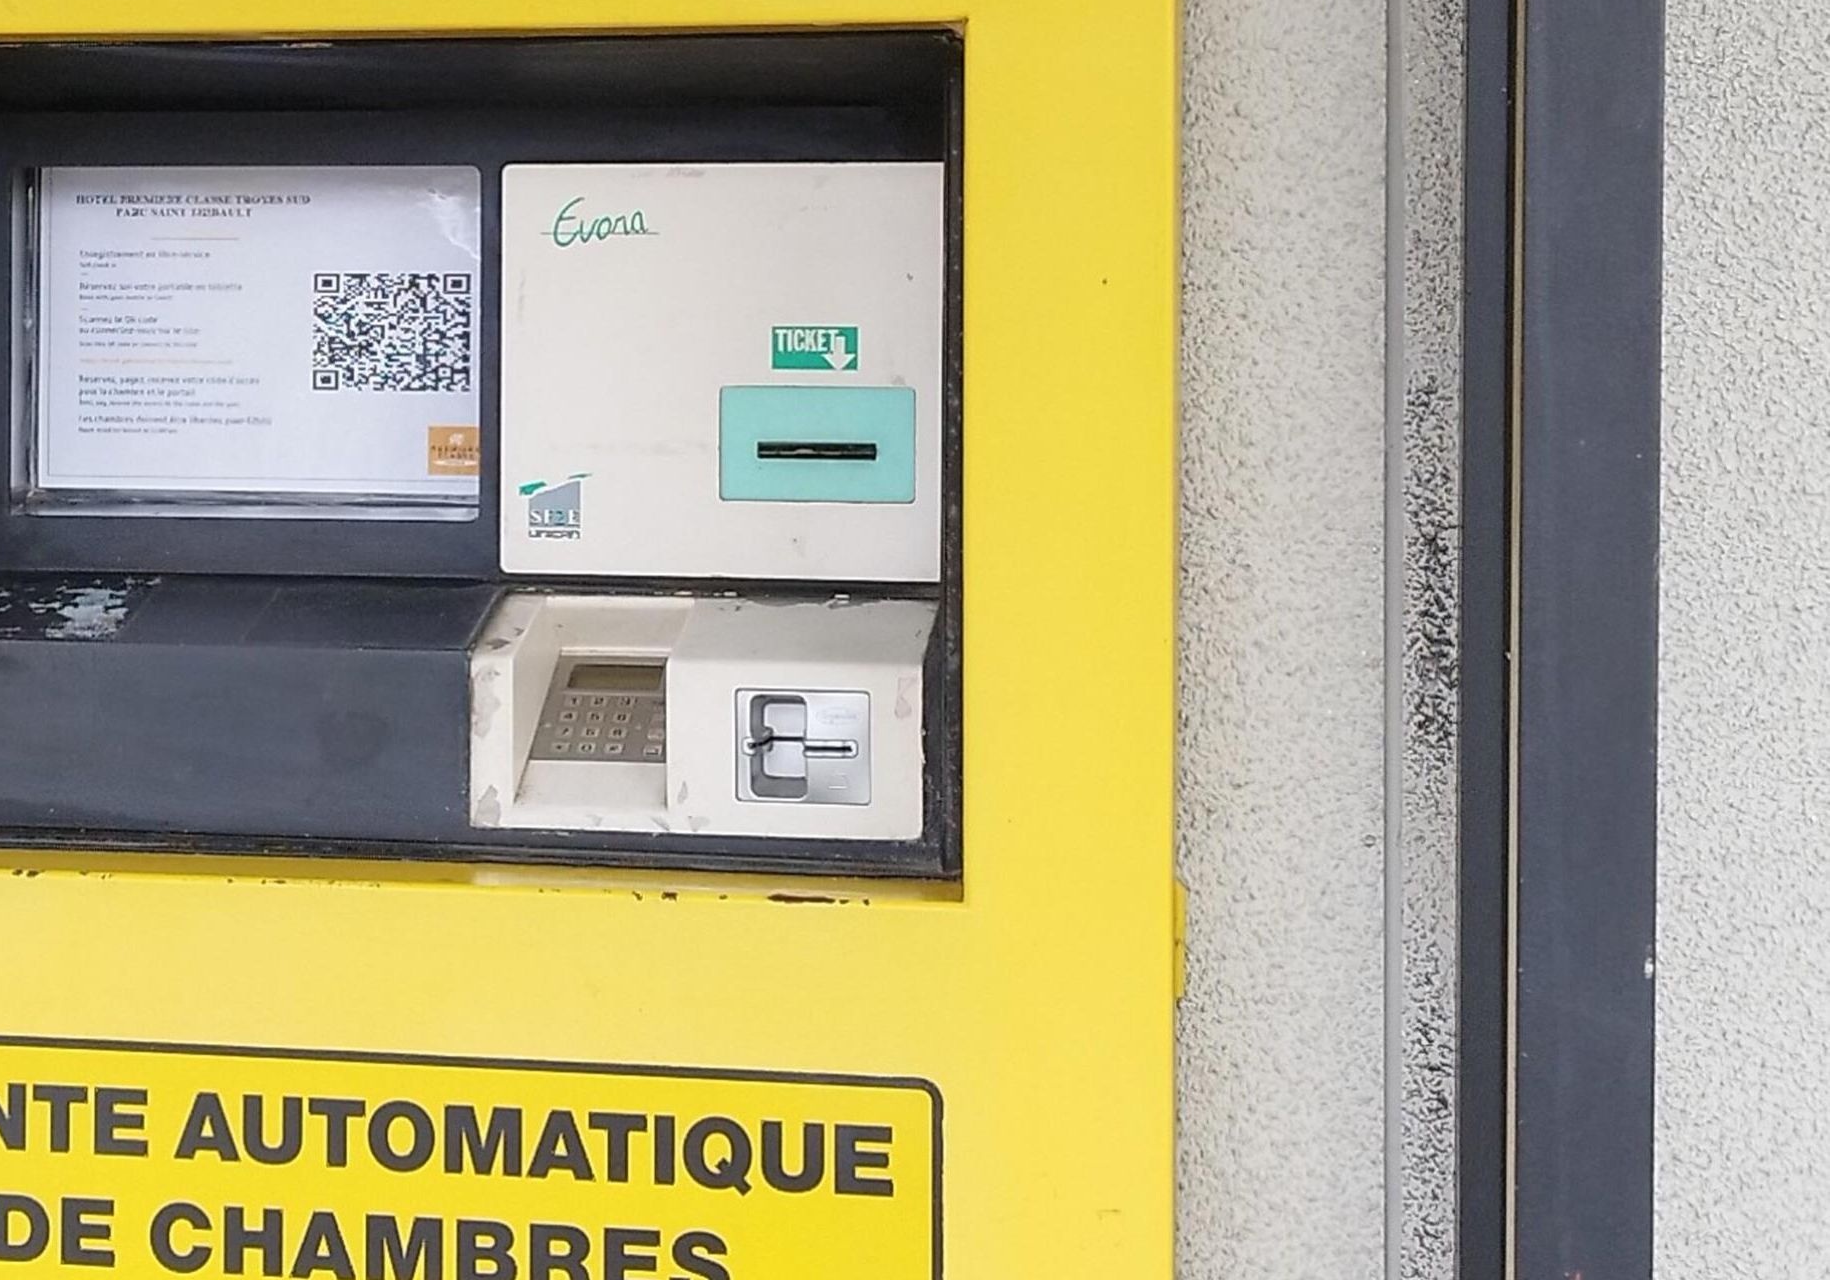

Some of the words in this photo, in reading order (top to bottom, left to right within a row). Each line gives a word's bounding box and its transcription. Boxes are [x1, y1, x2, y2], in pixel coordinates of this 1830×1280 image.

[76, 194, 118, 205] HOTEL
[185, 194, 232, 205] CLASSE
[235, 194, 284, 205] TROYES
[285, 194, 311, 205] SUD
[150, 207, 187, 218] SAINT
[775, 328, 839, 352] TICKET
[173, 1091, 895, 1199] AUTOMATIQUE
